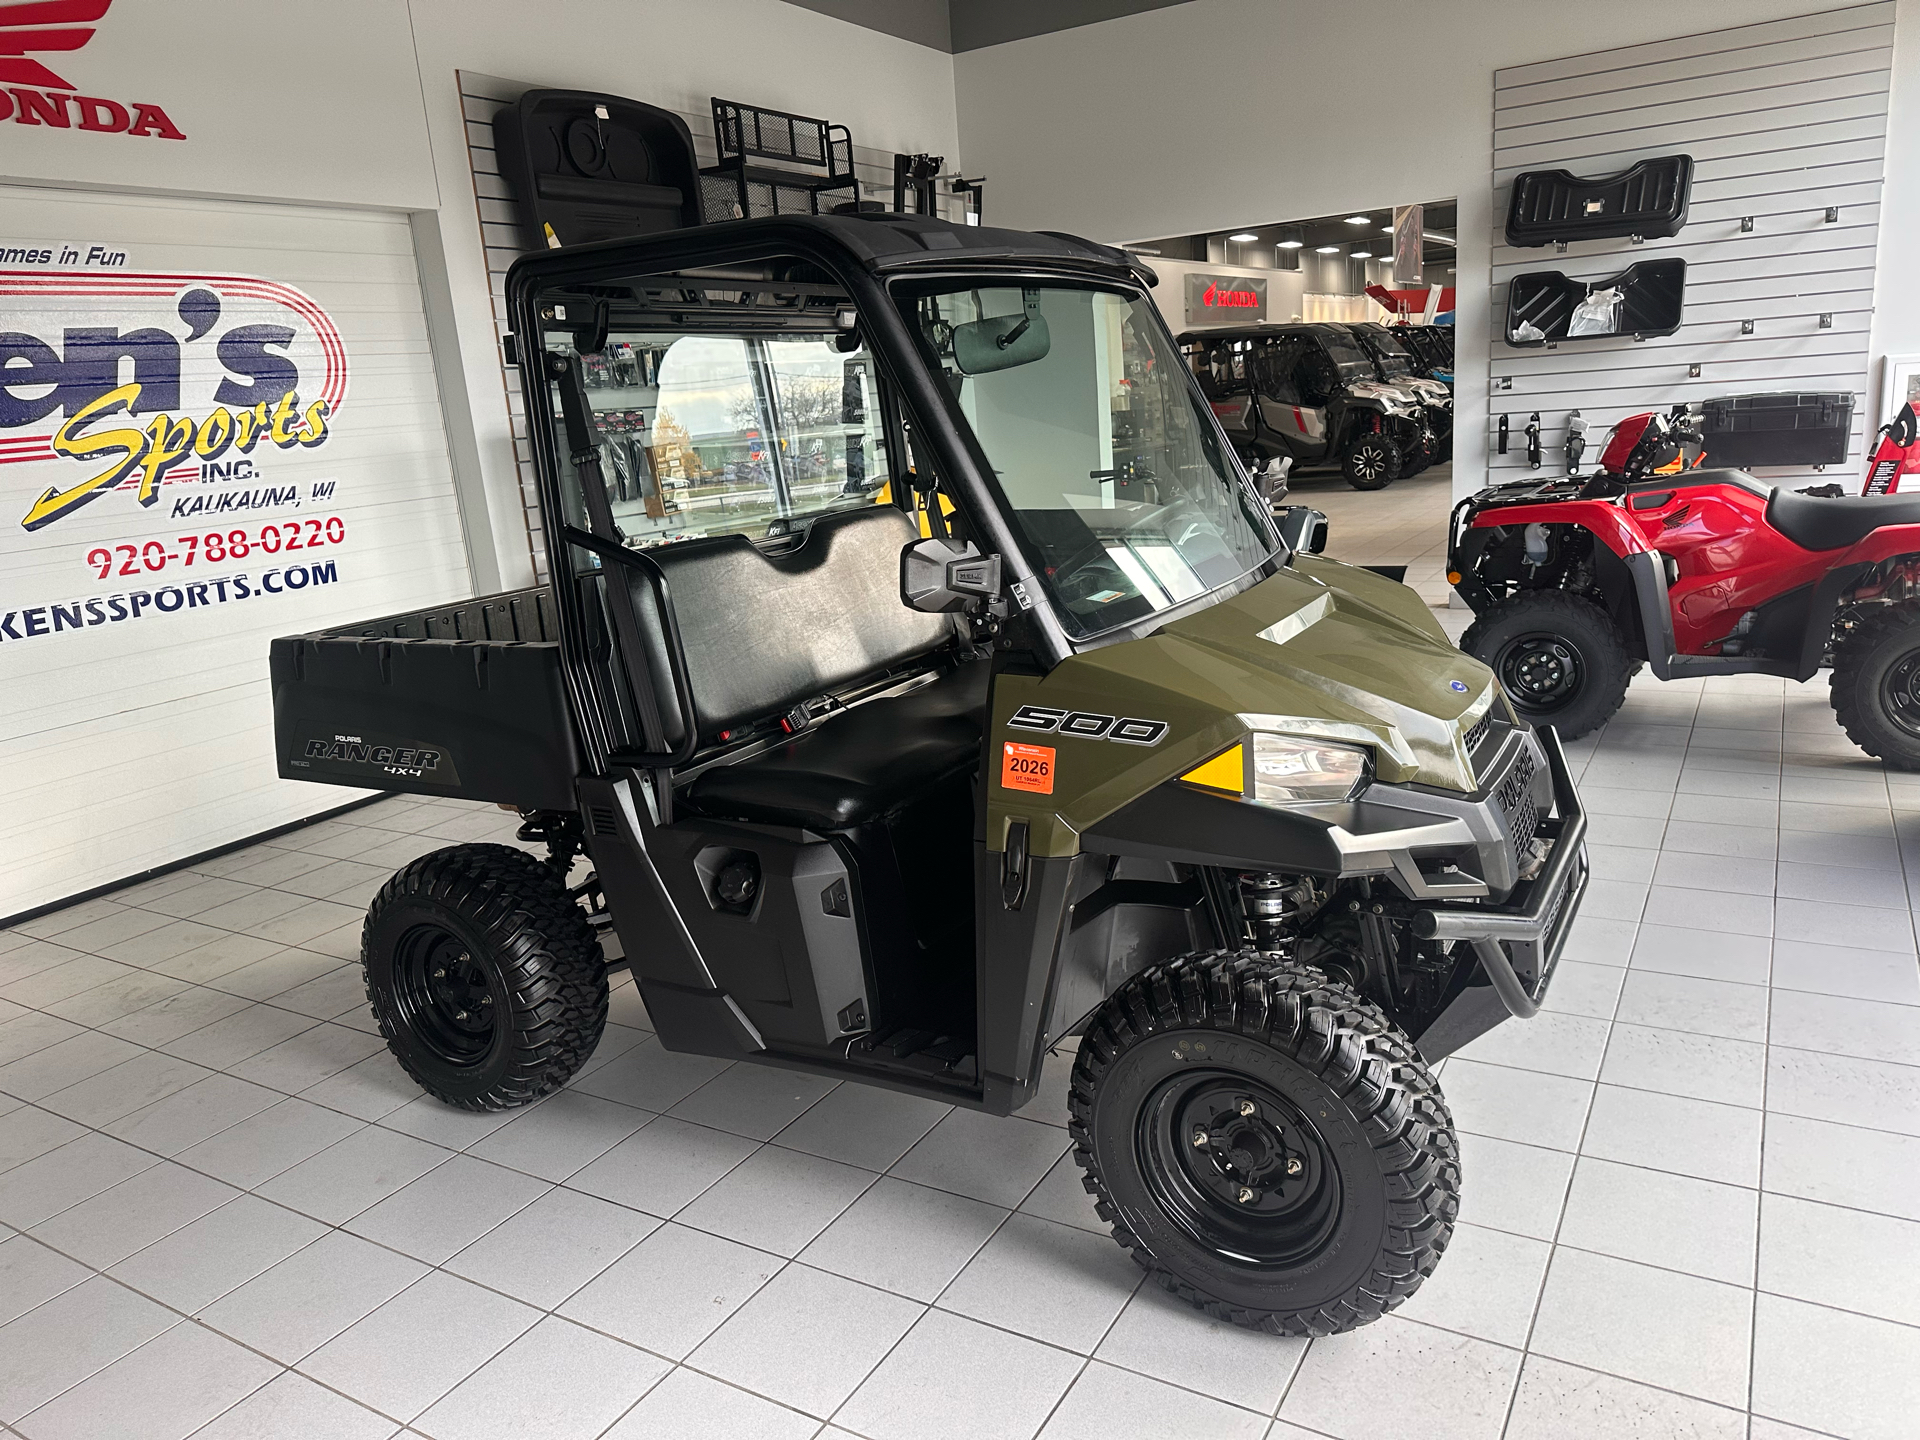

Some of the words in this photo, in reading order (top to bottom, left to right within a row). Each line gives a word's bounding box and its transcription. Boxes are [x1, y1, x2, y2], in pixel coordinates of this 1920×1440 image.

[58, 246, 79, 264] in
[85, 246, 125, 266] Fun
[1217, 289, 1259, 308] HONDA
[21, 383, 330, 532] Sports
[201, 459, 260, 484] INC.
[171, 485, 302, 519] KAUKAUNA,
[311, 481, 336, 502] WI
[86, 516, 346, 580] 920-788-0220
[0, 559, 339, 642] KENSSPORTS.COM
[334, 734, 362, 744] POLARIS
[1006, 704, 1171, 747] 500
[304, 739, 442, 770] RANGER
[1010, 757, 1049, 776] 2026
[1495, 744, 1536, 814] POLARIS
